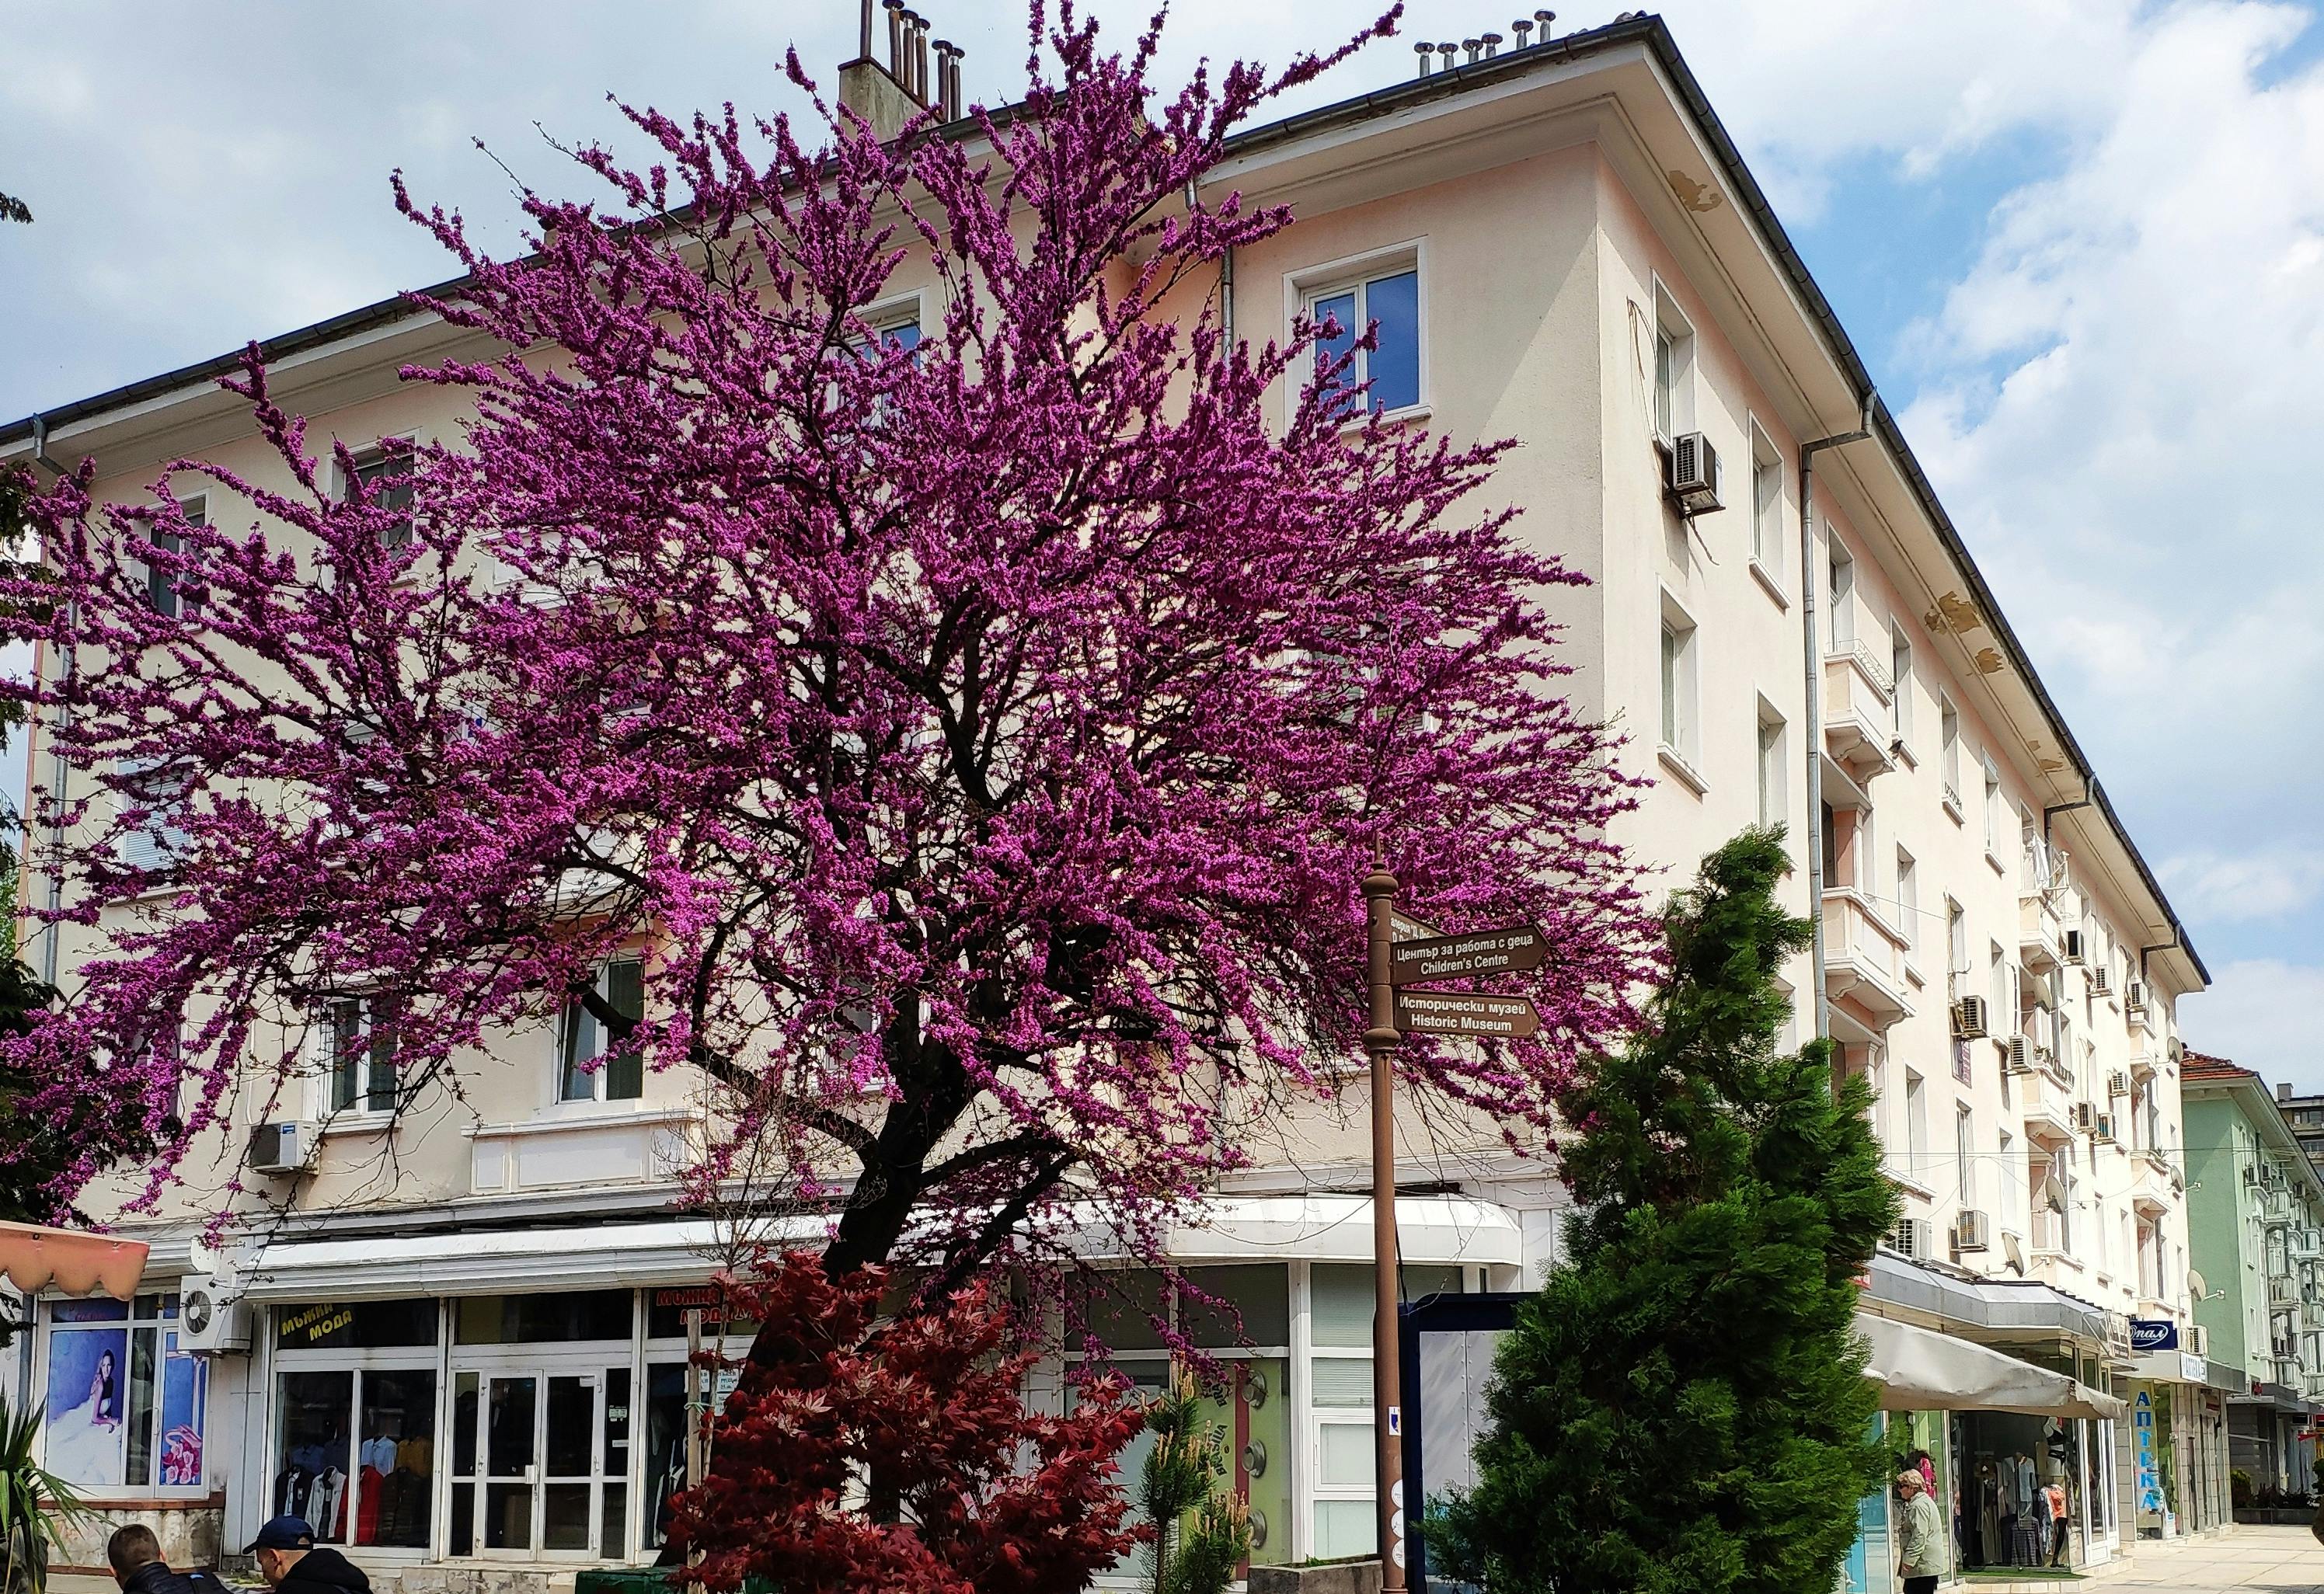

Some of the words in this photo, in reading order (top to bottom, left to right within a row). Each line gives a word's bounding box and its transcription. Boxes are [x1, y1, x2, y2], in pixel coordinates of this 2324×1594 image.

[1390, 917, 1411, 934] алерия
[1397, 947, 1439, 962] Център
[1441, 945, 1453, 955] за
[1455, 939, 1496, 957] работа
[1498, 938, 1506, 948] с
[1507, 934, 1534, 950] деца
[1420, 957, 1472, 975] Children's
[1474, 954, 1509, 968] Centre
[1399, 996, 1485, 1013] Исторически
[1488, 1002, 1526, 1016] музей
[1411, 1013, 1458, 1028] Historic
[1461, 1016, 1512, 1032] Museum
[309, 1310, 353, 1342] МОДА
[2136, 1391, 2156, 1509] АПТЕКА
